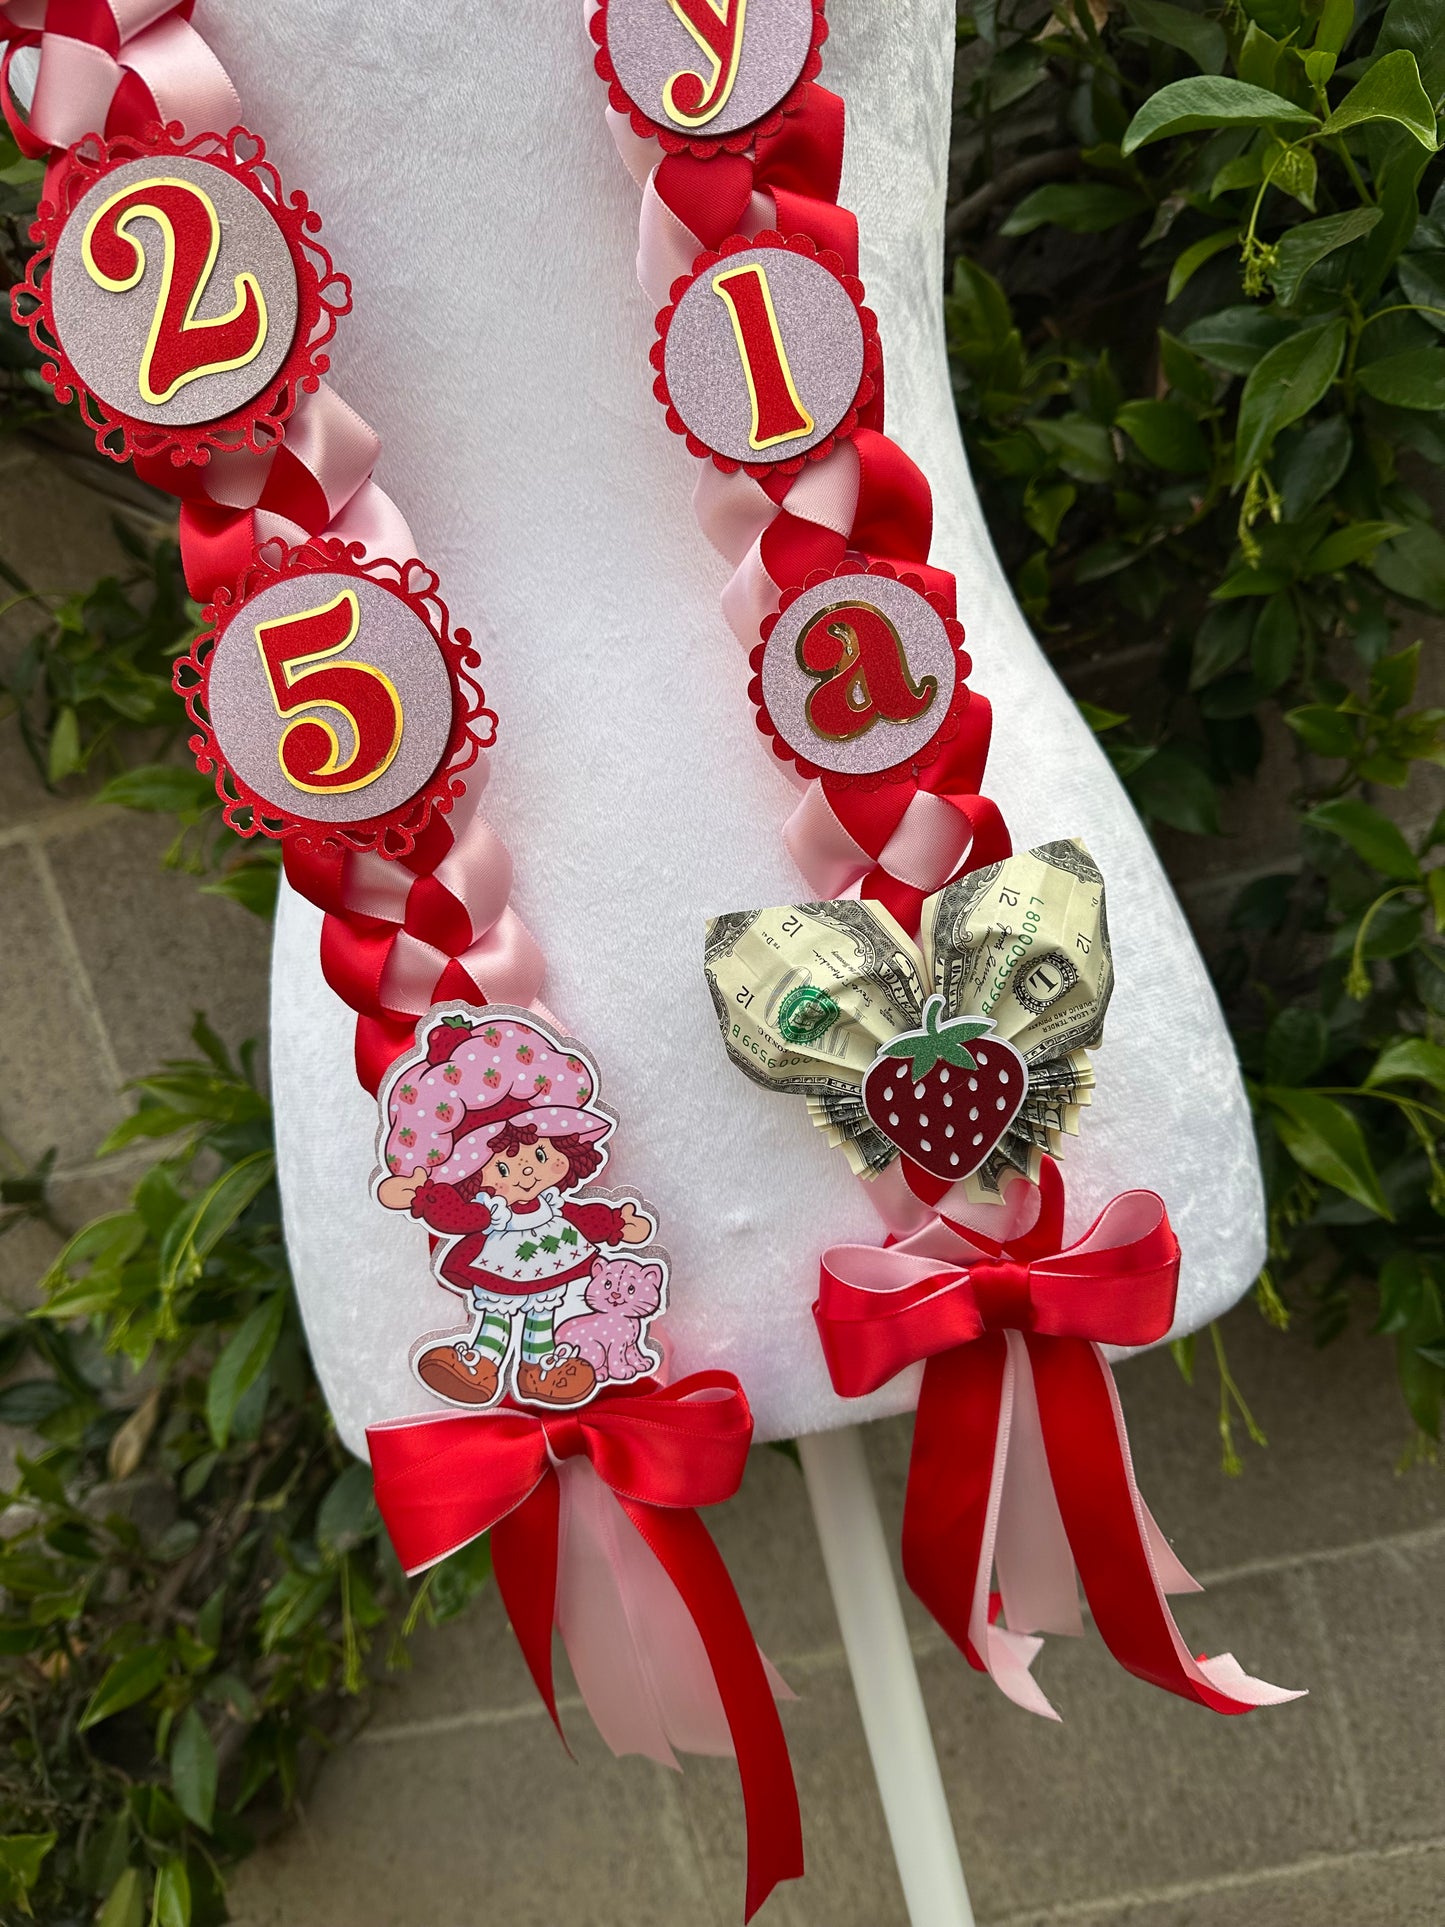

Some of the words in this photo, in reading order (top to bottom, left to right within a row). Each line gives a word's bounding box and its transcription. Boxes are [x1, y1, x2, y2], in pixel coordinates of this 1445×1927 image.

[663, 0, 746, 127] y
[81, 176, 269, 406] 2
[255, 589, 404, 795] 5
[795, 600, 938, 743] a
[1028, 966, 1059, 993] L
[1042, 1019, 1069, 1033] TENDER
[1068, 1010, 1090, 1021] LEGAL
